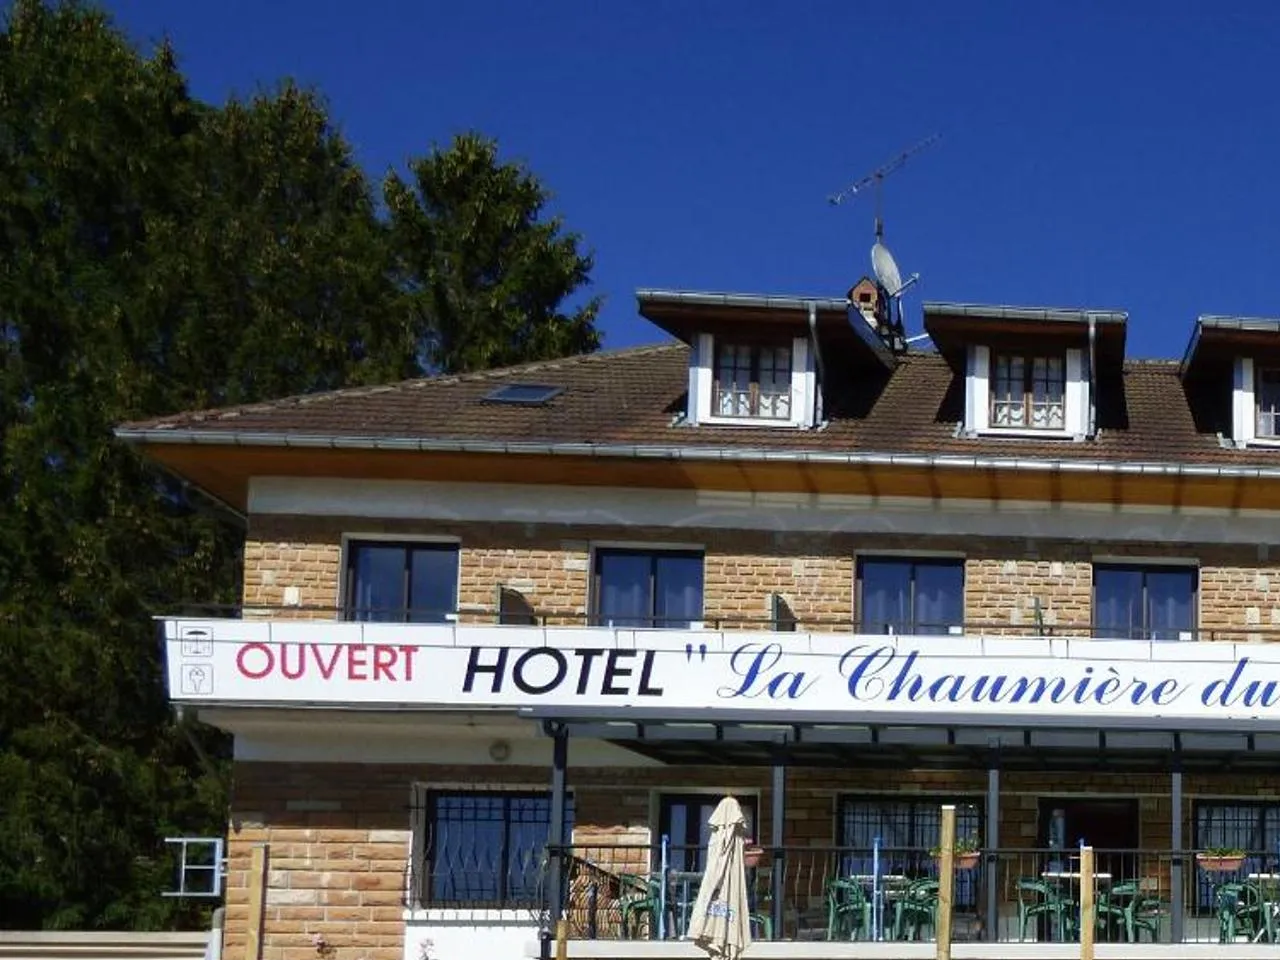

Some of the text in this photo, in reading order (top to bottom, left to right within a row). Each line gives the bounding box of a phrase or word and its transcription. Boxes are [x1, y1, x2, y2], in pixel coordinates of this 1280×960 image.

[236, 641, 419, 681] OUVERT
[462, 646, 665, 695] HOTEL
[838, 644, 1193, 705] Chaumière
